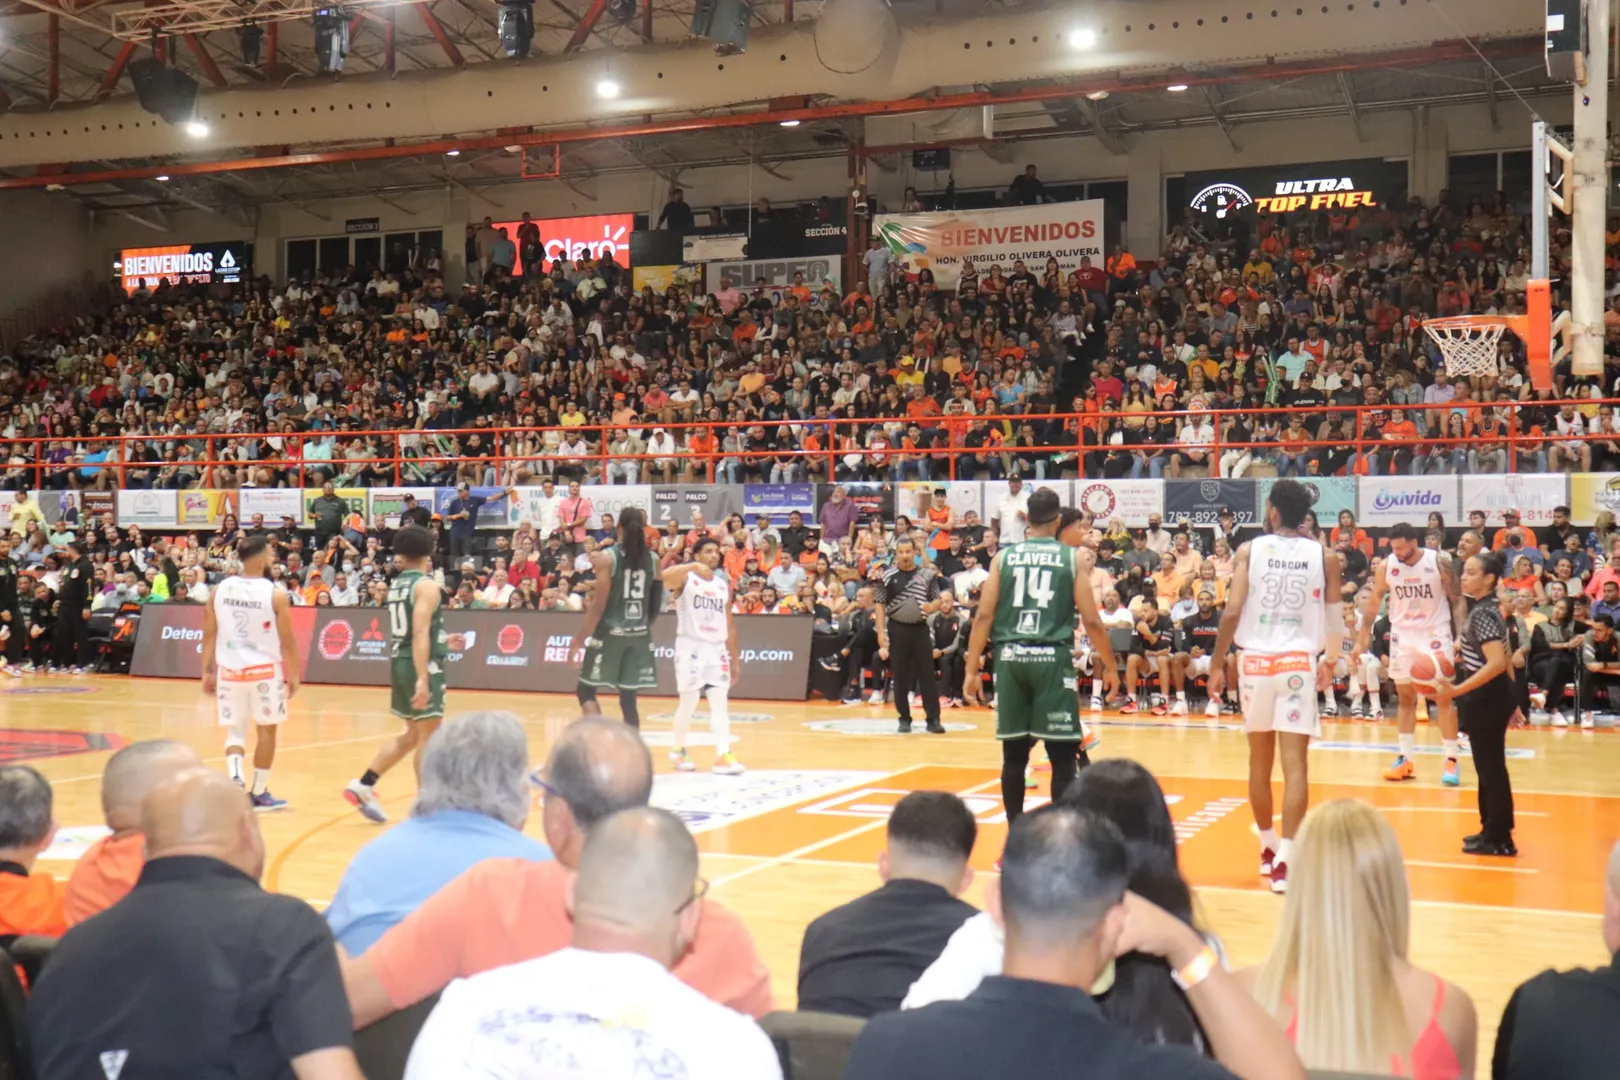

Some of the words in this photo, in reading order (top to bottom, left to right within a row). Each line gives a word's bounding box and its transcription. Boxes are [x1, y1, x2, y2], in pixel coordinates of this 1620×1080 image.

[1275, 177, 1354, 195] ULTRA
[1254, 197, 1306, 213] TOP
[1311, 191, 1377, 210] FUEL
[805, 226, 838, 237] SECCIÓN
[839, 226, 847, 235] 4
[940, 220, 1096, 248] BIENVENIDOS
[544, 238, 616, 264] Claro
[936, 257, 960, 265] HON.
[963, 254, 1006, 264] VIRGILIO
[1014, 250, 1051, 261] OLIVERA
[1055, 247, 1100, 258] OLIVERA
[124, 252, 213, 276] BIENVENIDOS
[660, 505, 671, 520] 2
[1007, 553, 1064, 568] CLAVELL
[1268, 559, 1309, 570] GORDON
[624, 569, 646, 598] 13
[1013, 567, 1055, 608] 14
[1261, 573, 1308, 611] 35
[1395, 584, 1433, 600] CUNA
[693, 595, 724, 613] CUNA
[233, 611, 249, 638] 2
